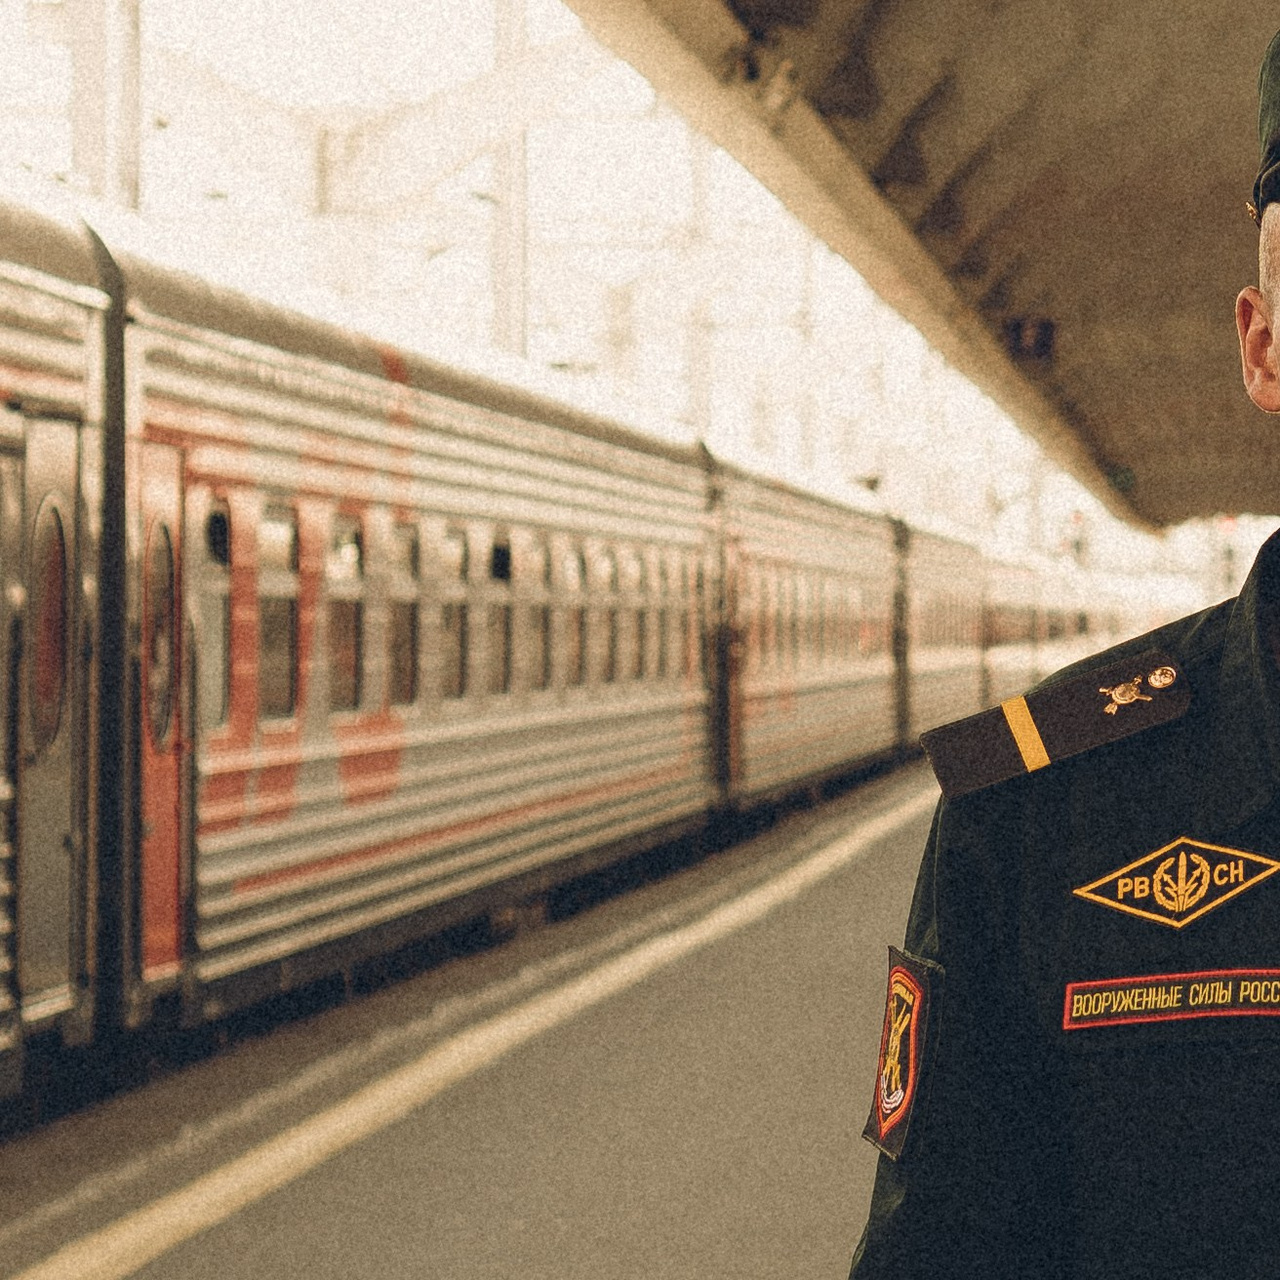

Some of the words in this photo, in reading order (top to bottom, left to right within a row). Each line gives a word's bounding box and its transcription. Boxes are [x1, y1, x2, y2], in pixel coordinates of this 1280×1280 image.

[1117, 877, 1150, 899] РВ
[1213, 860, 1244, 885] СН
[1072, 985, 1182, 1017] ВООРУЖЕННЫЕ
[1189, 981, 1232, 1006] СИЛЫ
